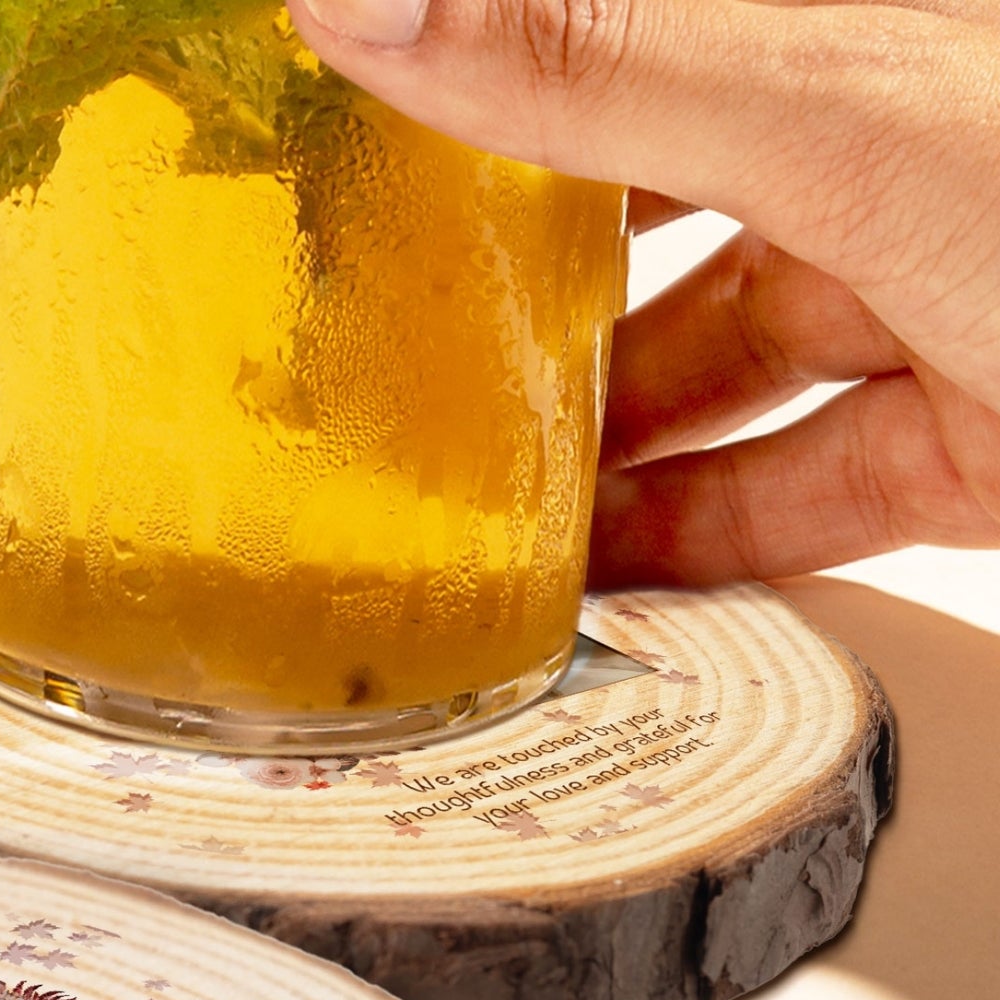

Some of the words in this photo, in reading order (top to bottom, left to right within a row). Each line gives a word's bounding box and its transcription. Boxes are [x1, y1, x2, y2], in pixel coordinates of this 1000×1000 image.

[384, 762, 570, 827] thoughtfulness
[569, 745, 613, 767] and
[613, 719, 693, 756] grateful
[685, 710, 721, 727] for
[402, 775, 455, 794] We
[455, 760, 502, 781] are
[497, 726, 592, 765] touched
[585, 722, 625, 737] by
[622, 707, 665, 731] your
[472, 797, 532, 828] your
[529, 780, 588, 804] love
[586, 763, 631, 786] and
[628, 736, 715, 770] support.
